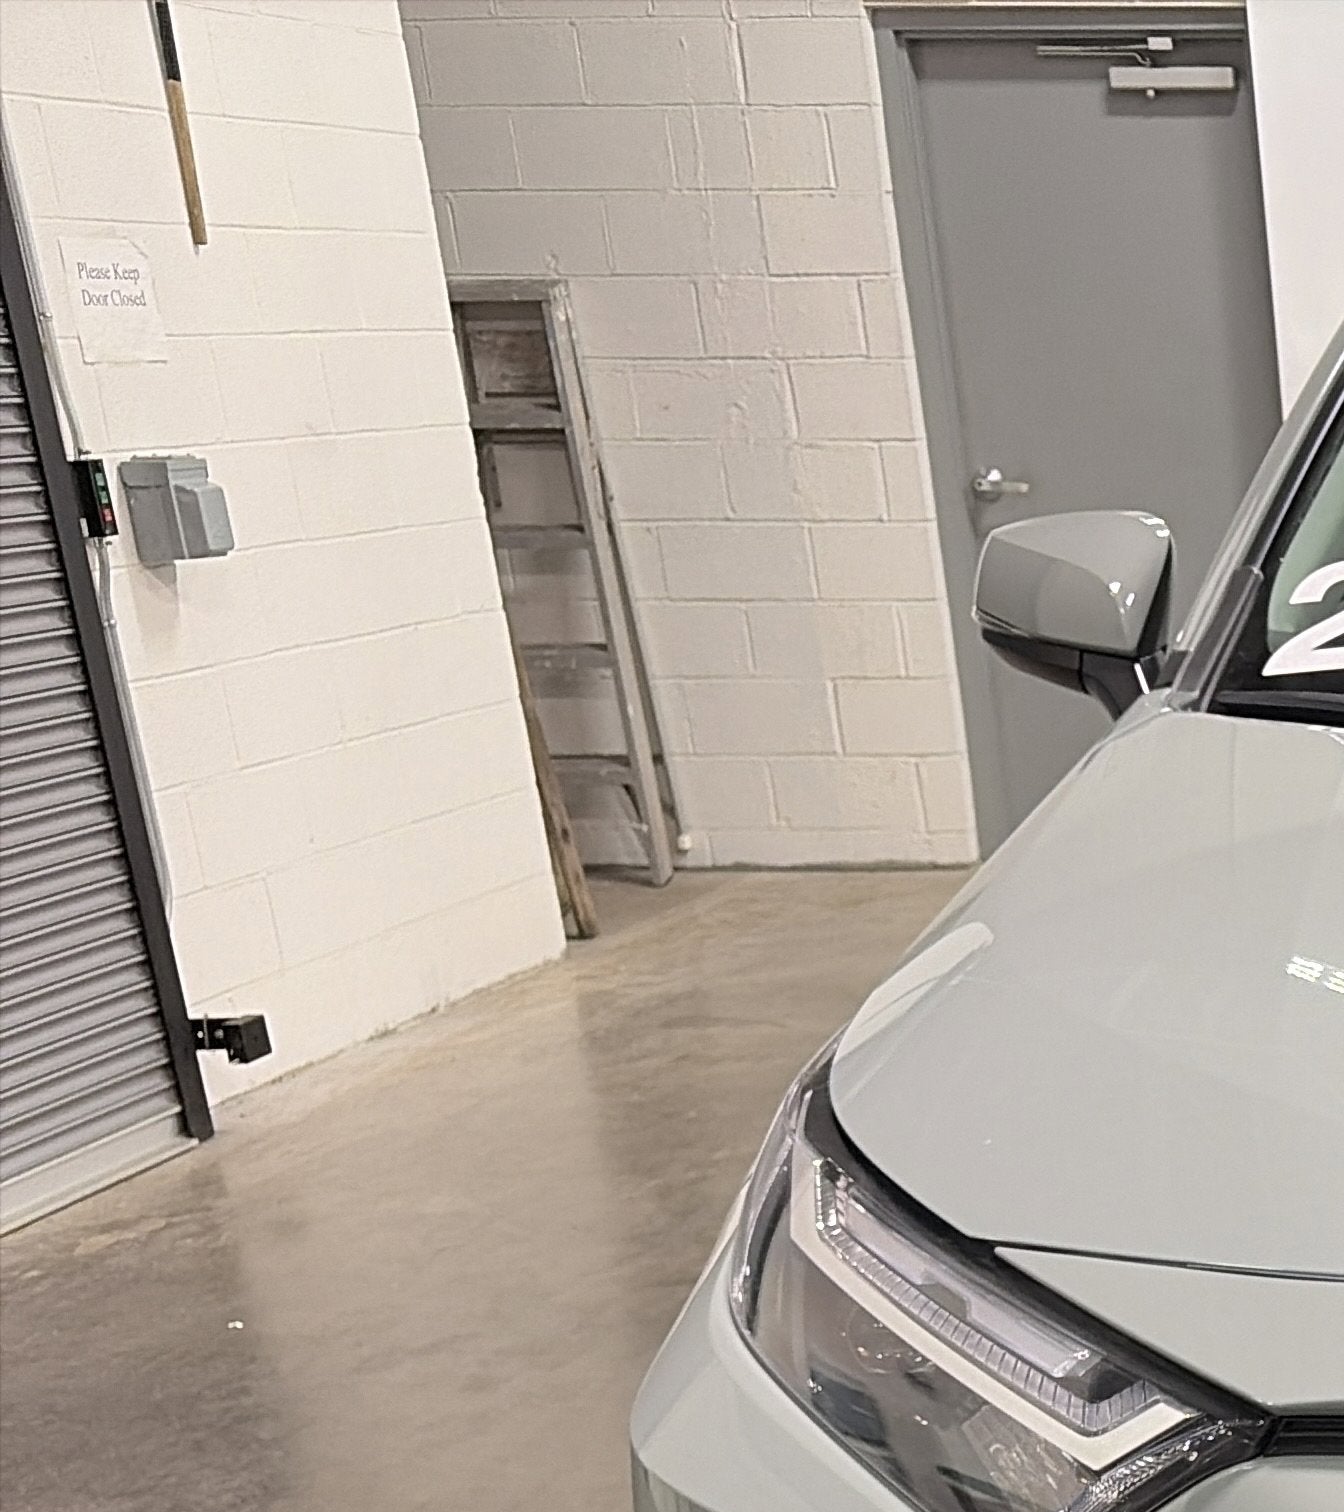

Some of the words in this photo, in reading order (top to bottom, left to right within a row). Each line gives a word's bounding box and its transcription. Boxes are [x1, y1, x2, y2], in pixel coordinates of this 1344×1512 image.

[77, 262, 110, 280] Please
[112, 262, 140, 285] Keep
[81, 289, 109, 306] Door
[110, 289, 147, 307] Closed
